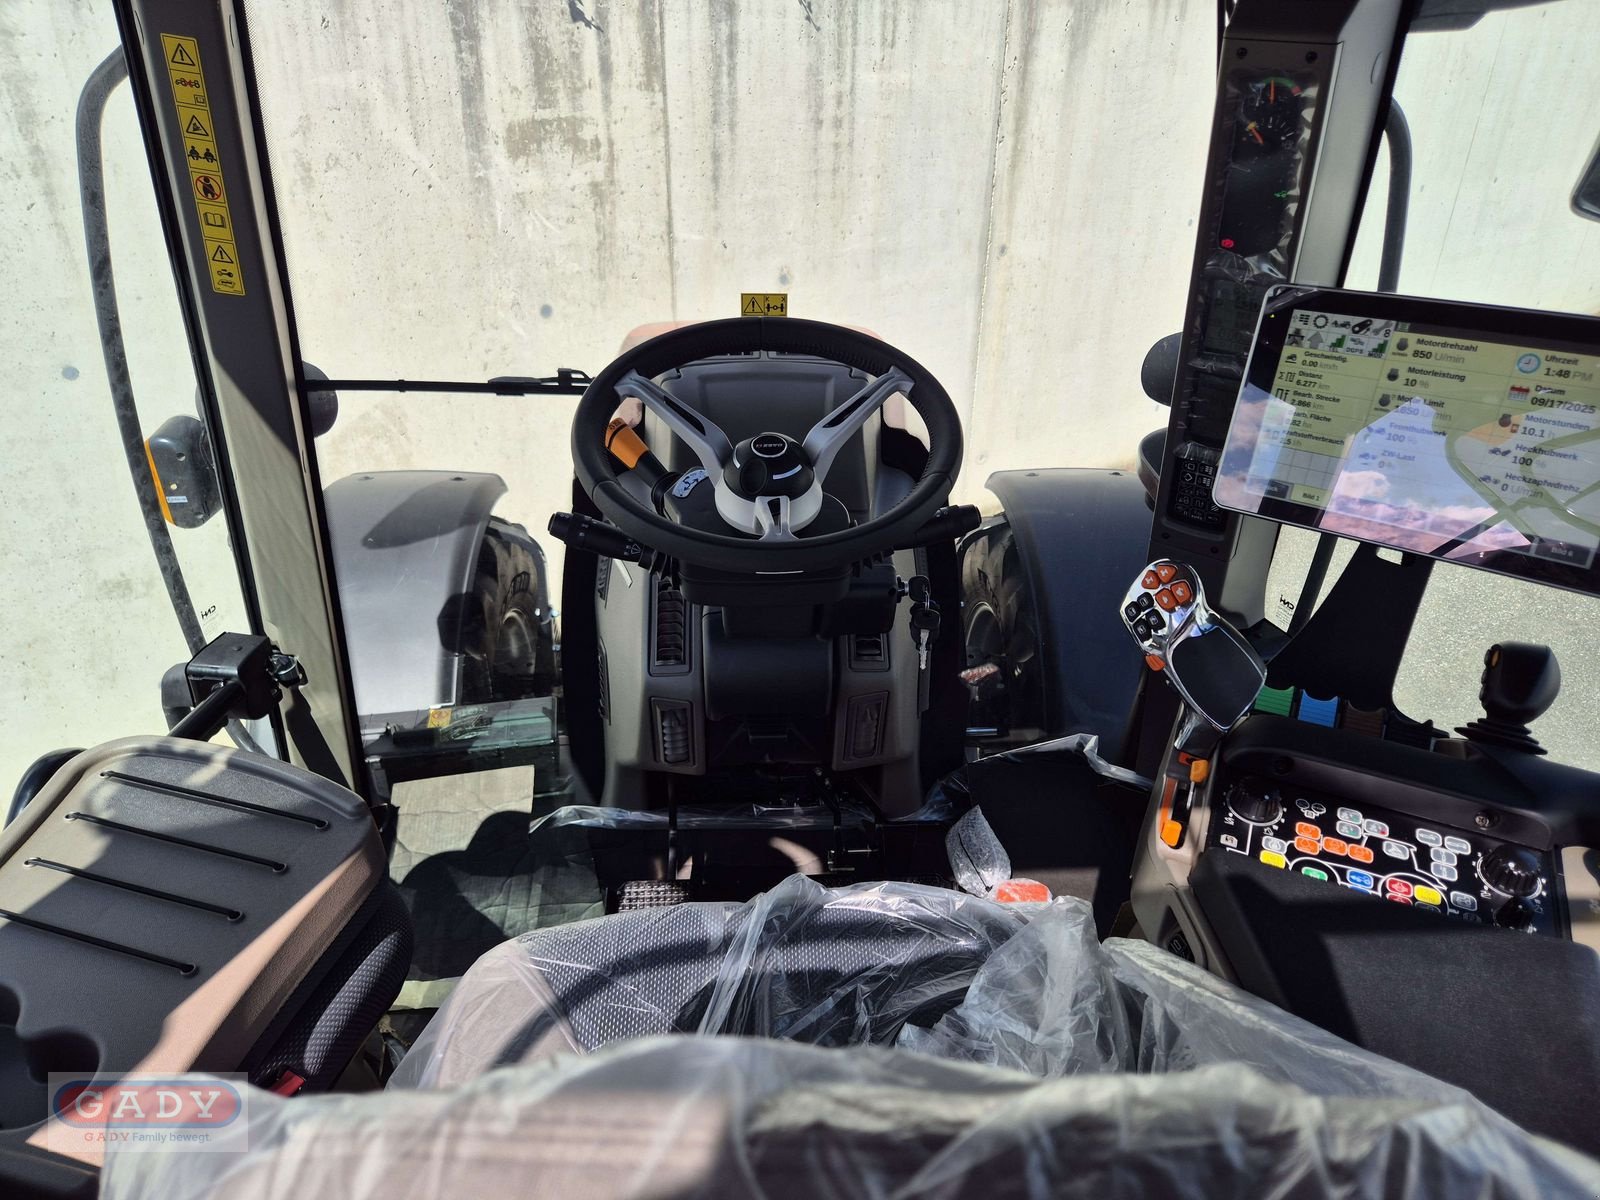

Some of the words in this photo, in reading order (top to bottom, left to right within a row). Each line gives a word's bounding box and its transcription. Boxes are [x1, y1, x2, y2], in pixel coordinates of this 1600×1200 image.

[1383, 329, 1391, 338] 8
[1416, 338, 1478, 352] Motordrehzahl
[1412, 350, 1432, 359] 850
[1434, 353, 1465, 364] U/min
[1544, 355, 1578, 365] Uhrzeit
[1298, 371, 1323, 379] Distanz
[1407, 366, 1466, 382] Motorleistung
[1544, 367, 1571, 378] 1:48
[1571, 371, 1593, 381] PM
[1296, 380, 1317, 388] 6.277
[1404, 378, 1417, 387] 10
[1316, 394, 1341, 402] Strecke
[1531, 396, 1597, 414] 09/17/2025
[1525, 414, 1590, 431] Motorstunden
[1386, 433, 1405, 442] 100
[1521, 426, 1545, 438] 10.1
[1515, 443, 1578, 460] Heckhubwerk
[1511, 455, 1533, 466] 100
[1501, 483, 1509, 491] 0
